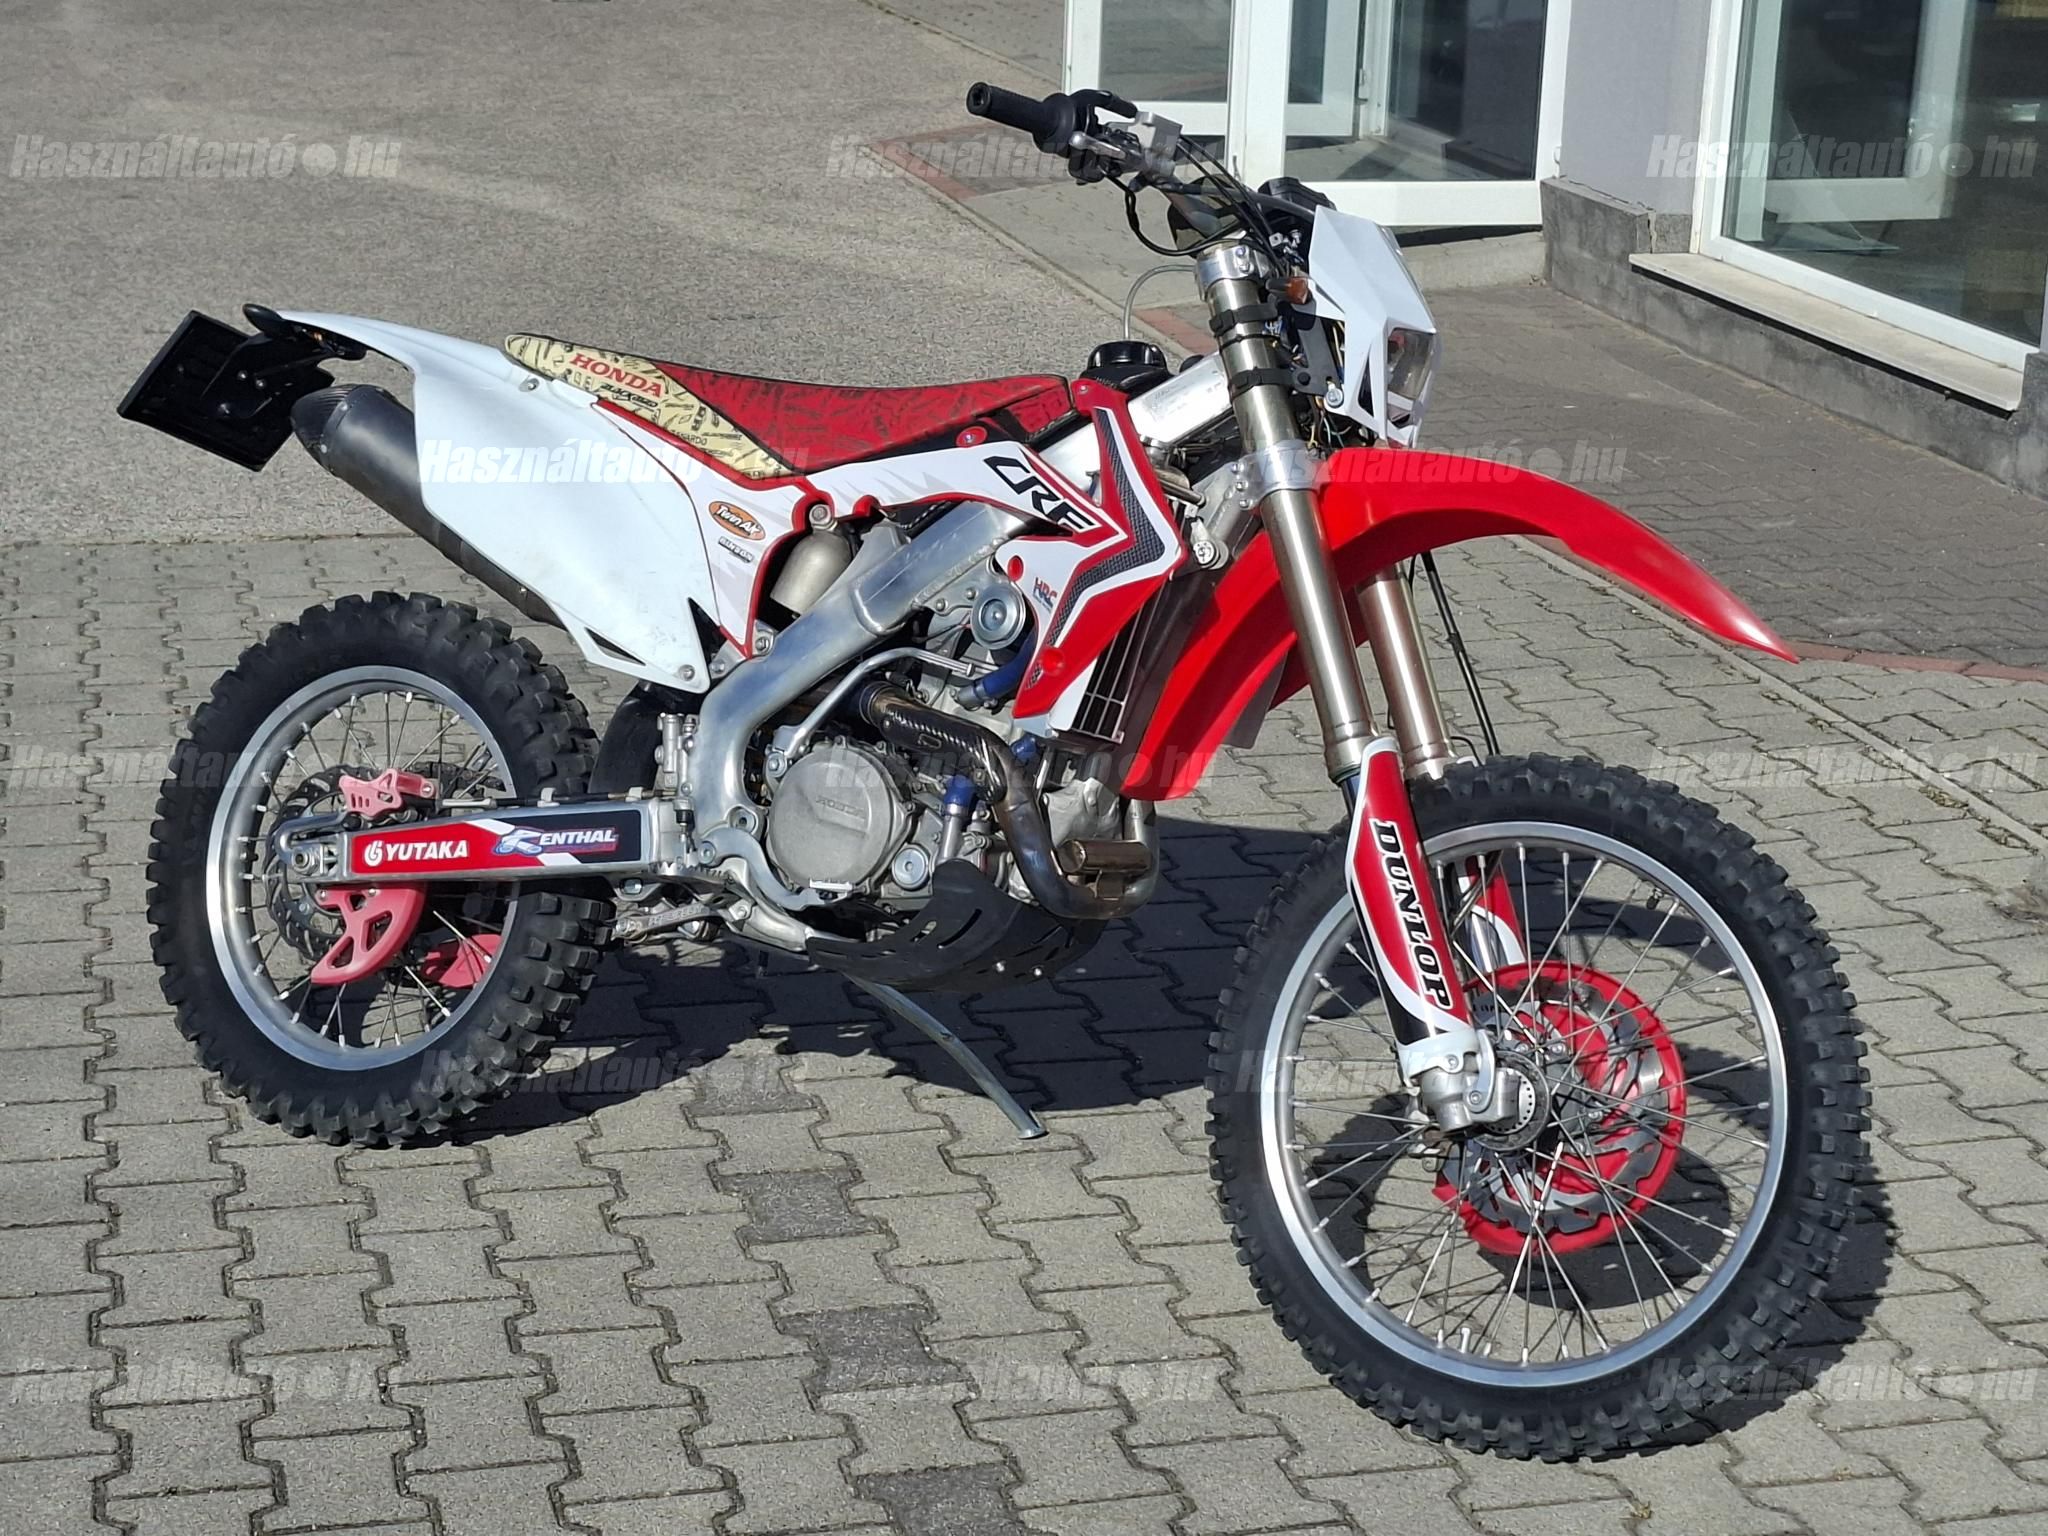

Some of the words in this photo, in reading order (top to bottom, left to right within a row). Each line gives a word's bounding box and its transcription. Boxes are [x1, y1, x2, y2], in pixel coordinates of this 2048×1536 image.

[569, 352, 663, 397] HONDA
[984, 455, 1097, 530] CRF
[385, 840, 469, 861] YUTAKA
[496, 828, 617, 855] RENTHAL
[1369, 818, 1454, 1009] DUNLOP
